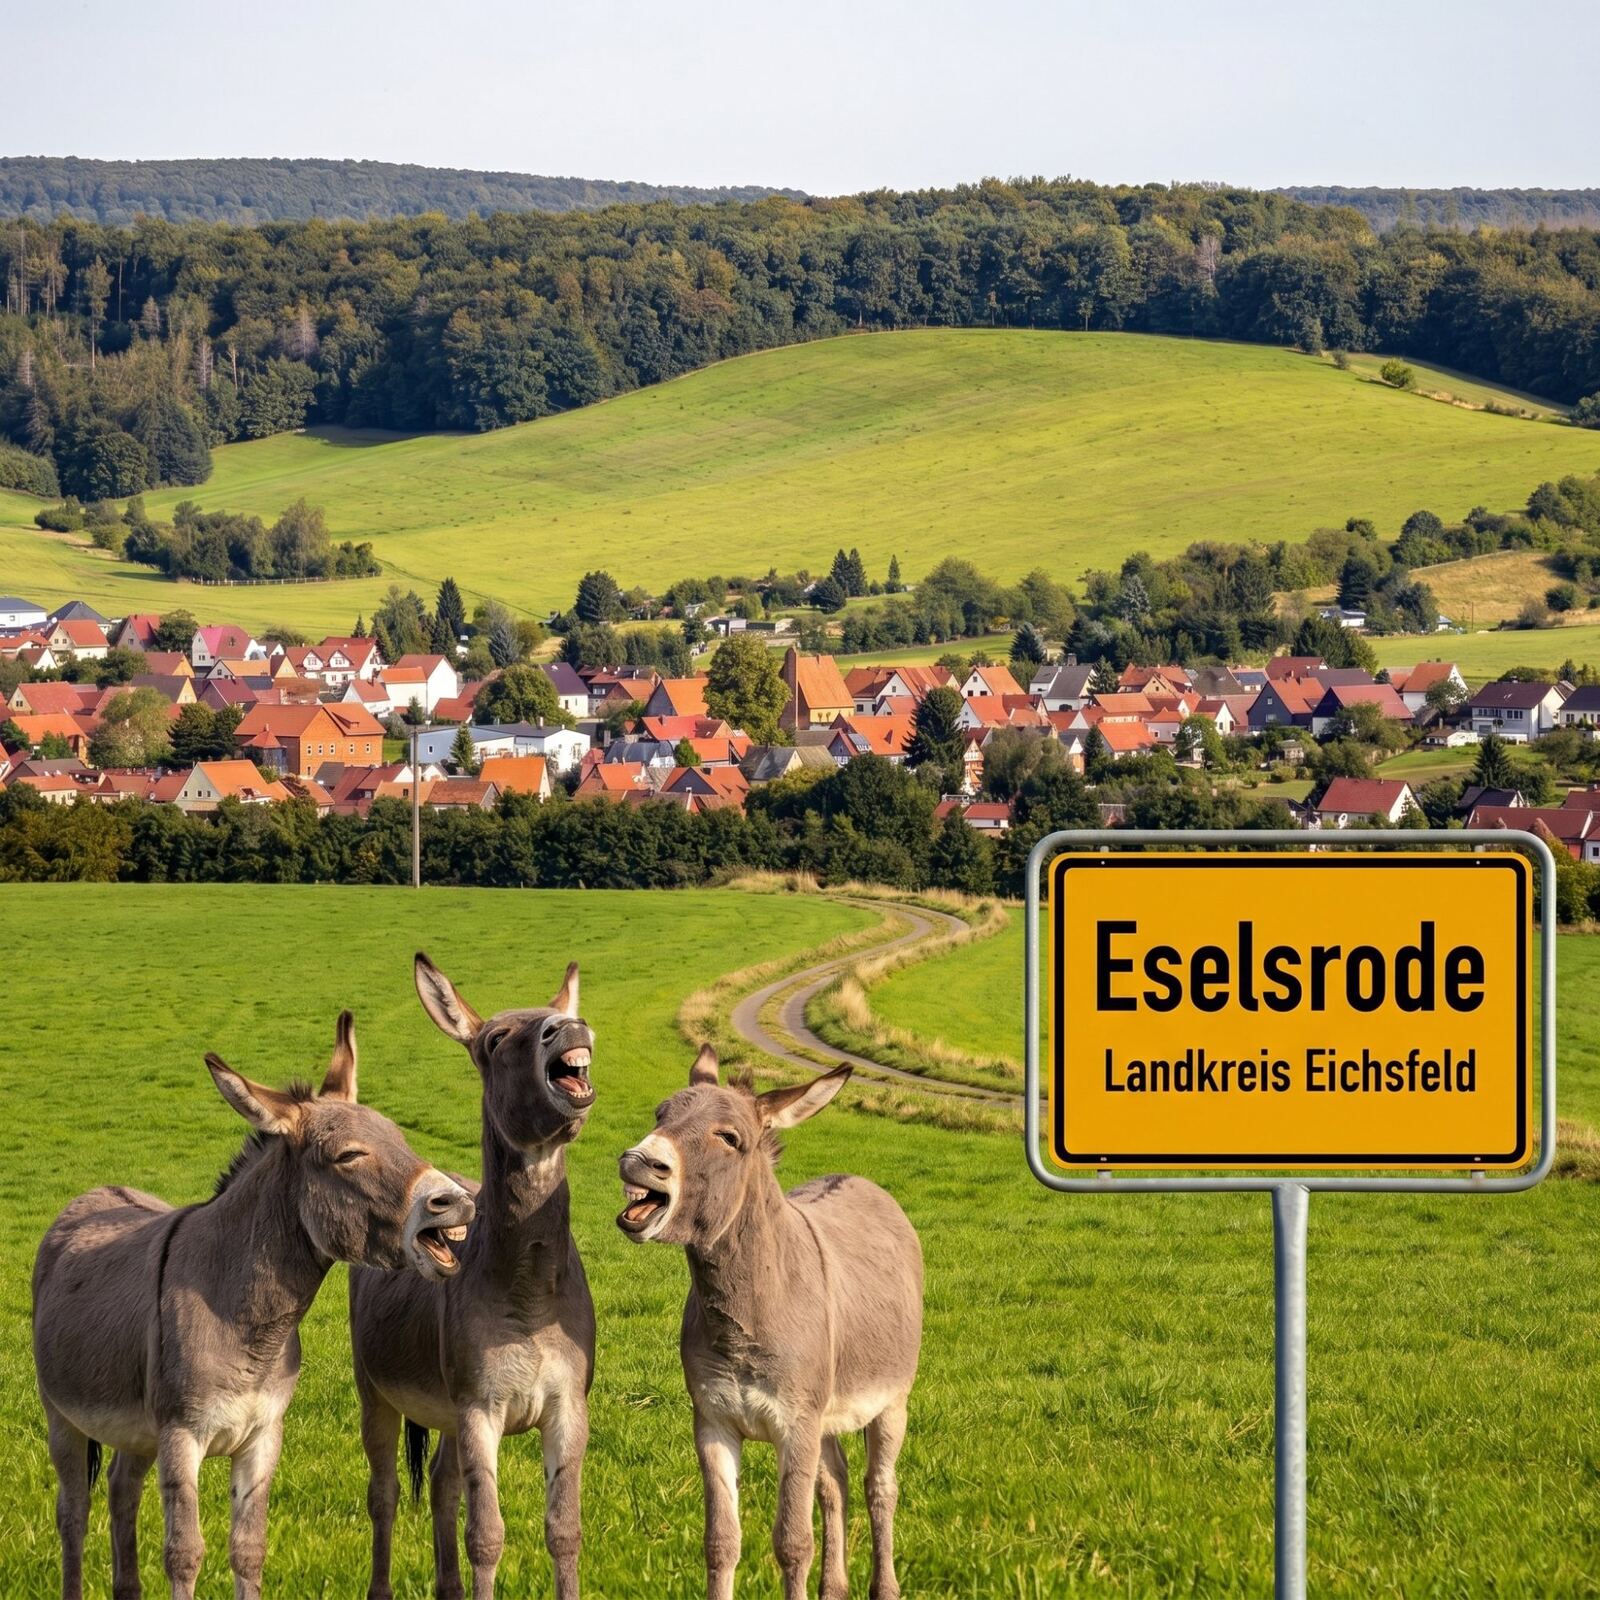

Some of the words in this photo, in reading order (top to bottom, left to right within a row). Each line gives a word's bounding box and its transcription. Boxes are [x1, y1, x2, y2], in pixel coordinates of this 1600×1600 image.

[1096, 920, 1485, 1013] Eselsrode
[1105, 1048, 1291, 1093] Landkreis
[1306, 1048, 1476, 1093] Eichsfeld
